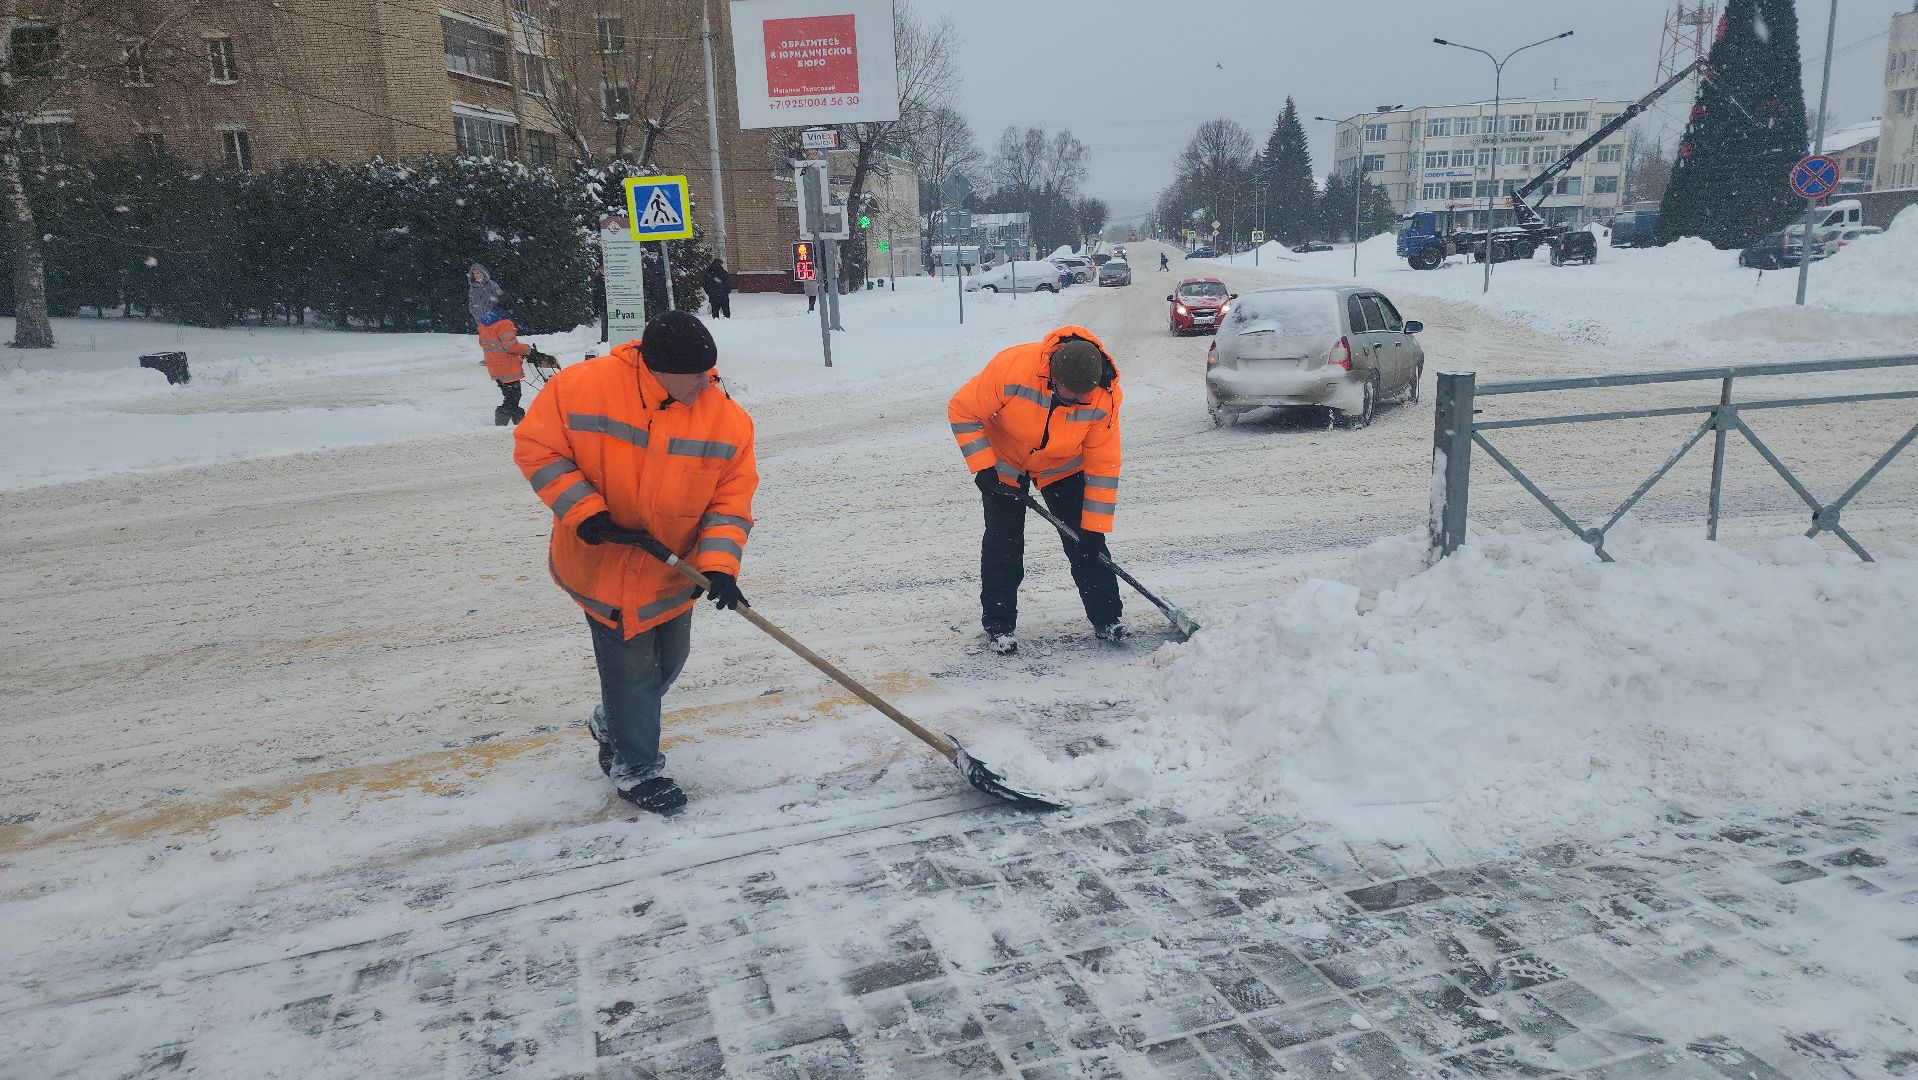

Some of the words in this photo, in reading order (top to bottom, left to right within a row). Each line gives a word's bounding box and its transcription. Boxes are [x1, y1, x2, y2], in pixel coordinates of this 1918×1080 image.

[781, 38, 840, 48] ОБРАТИТЕСЬ
[779, 47, 852, 59] ЮРИДИЧЕСКОЕ
[797, 59, 826, 68] БЮРО
[830, 97, 844, 106] 56
[846, 95, 859, 106] 30
[806, 132, 832, 140] VinEx
